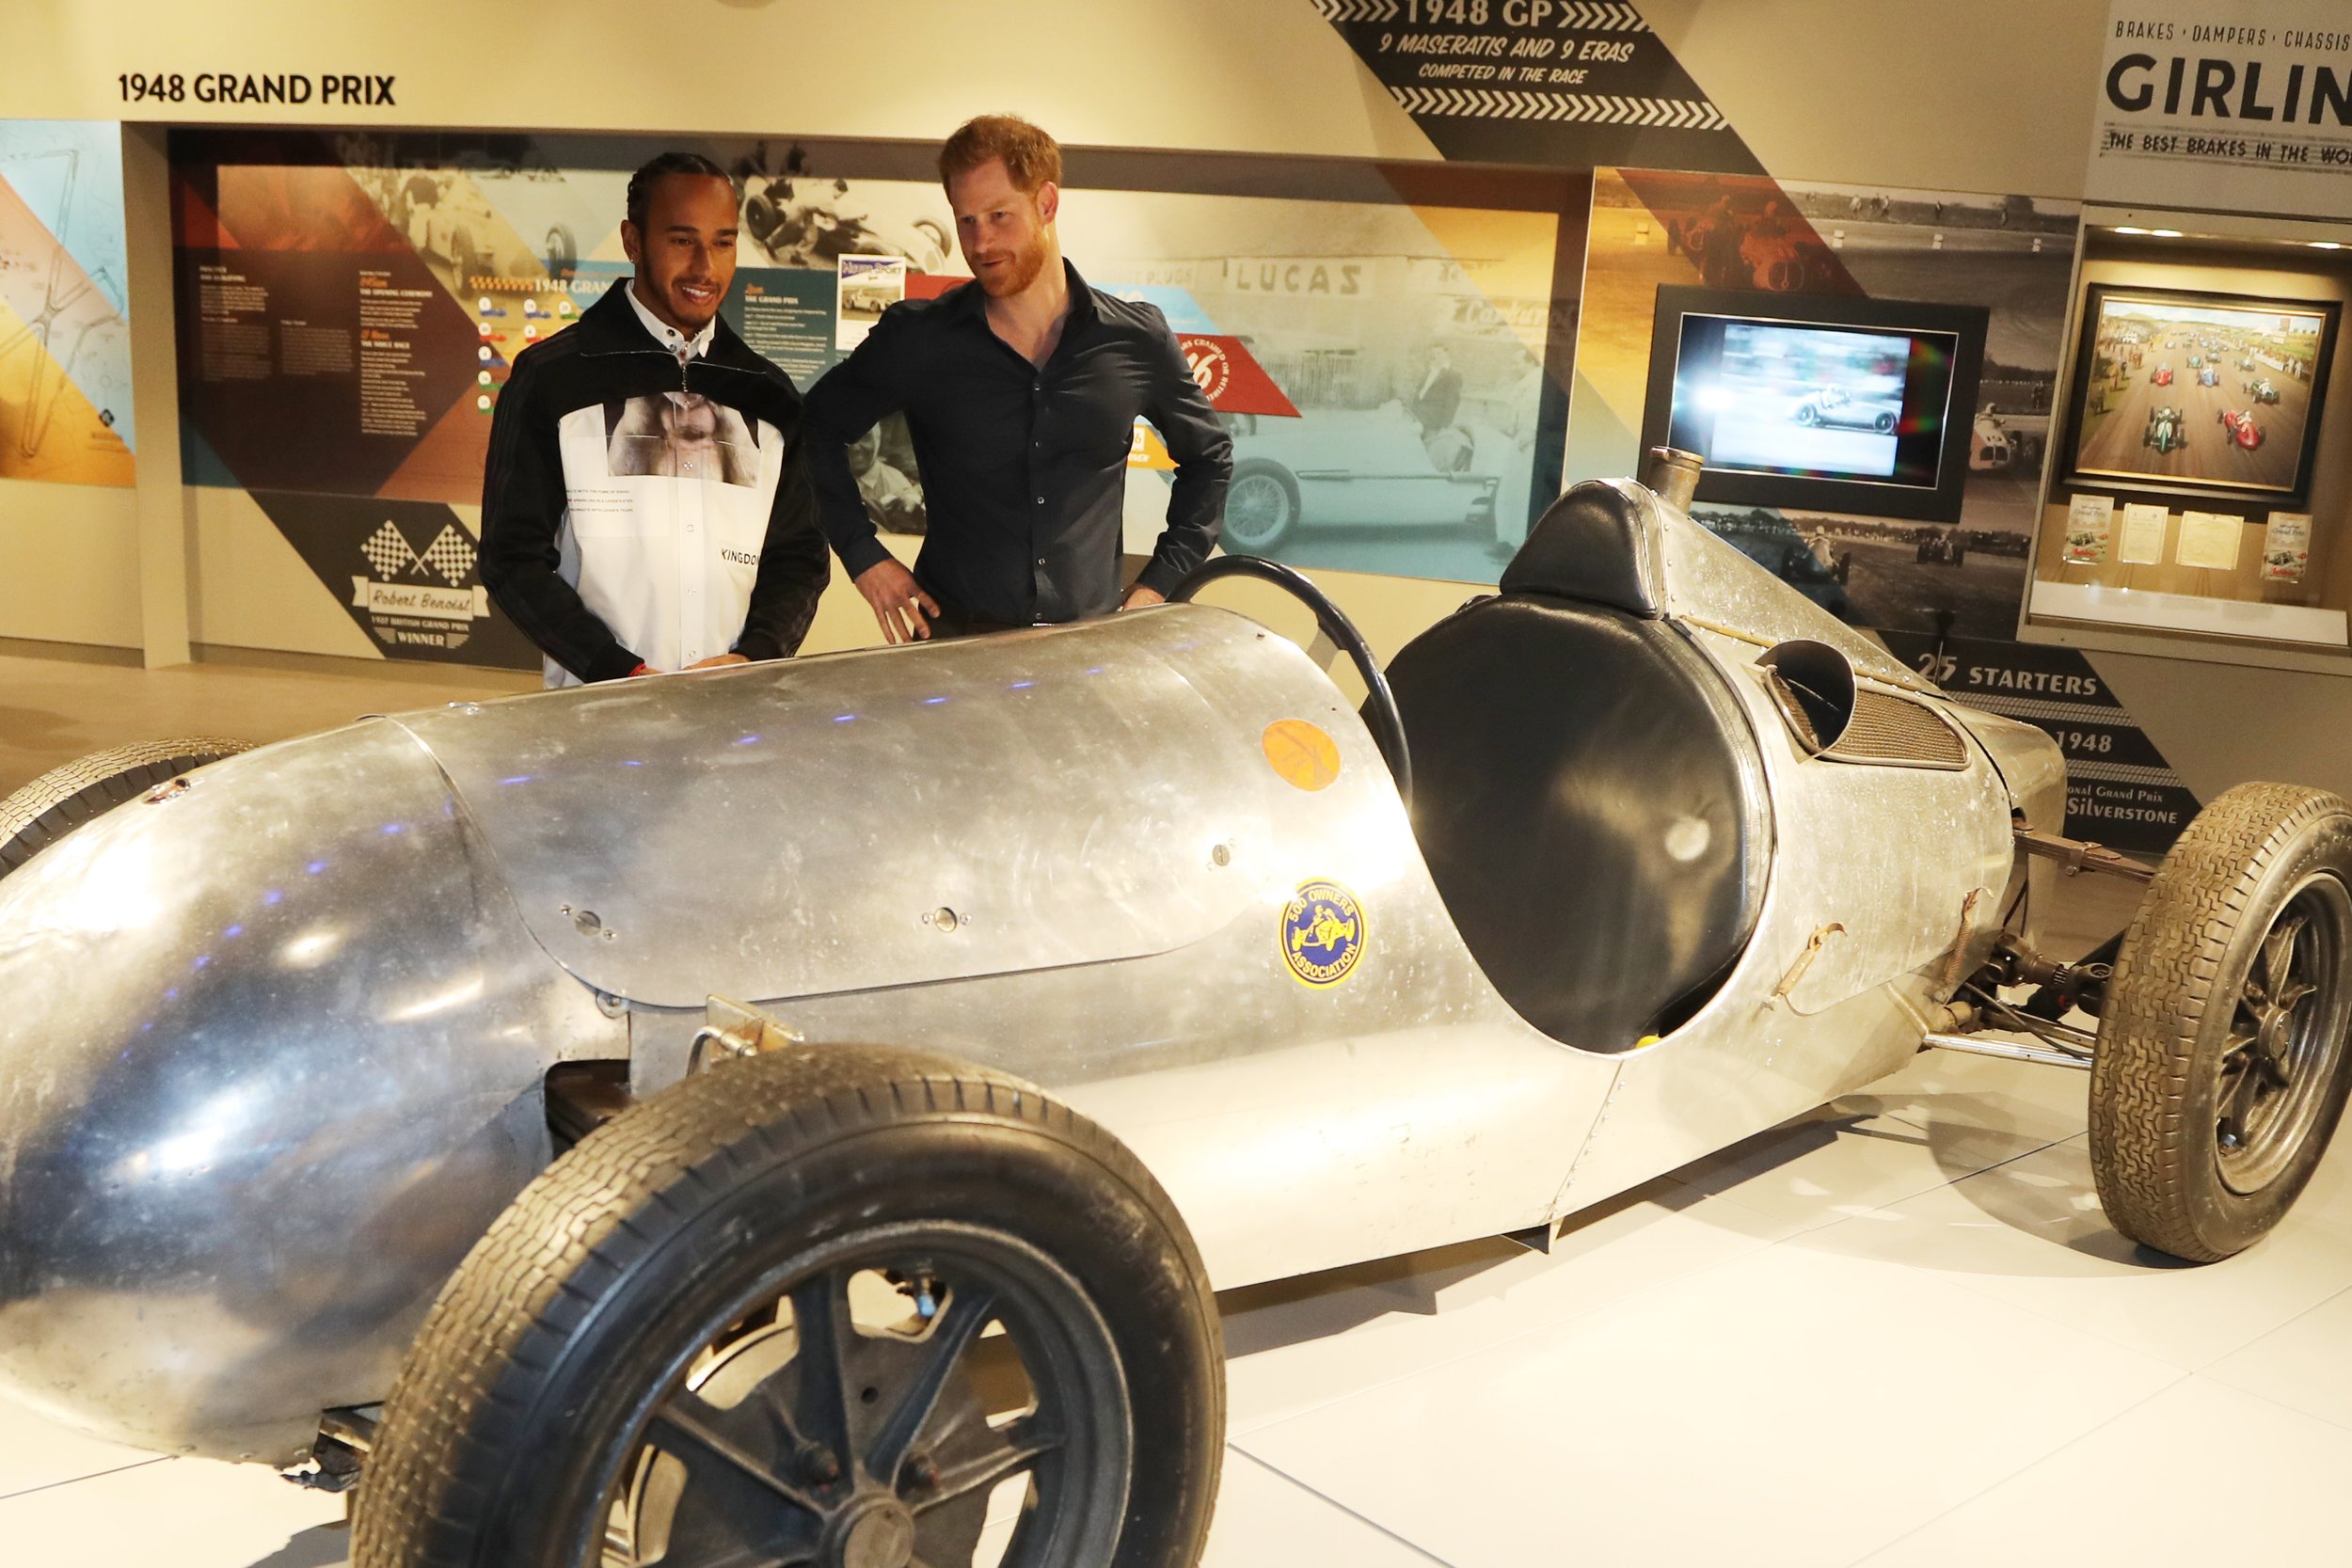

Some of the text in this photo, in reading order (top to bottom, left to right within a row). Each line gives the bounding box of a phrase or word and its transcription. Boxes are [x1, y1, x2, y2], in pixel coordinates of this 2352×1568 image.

[1406, 0, 1553, 27] 1948 GP
[1378, 33, 1635, 63] 9 MASERATIS AND 9 ERAS
[2116, 21, 2351, 52] BRAKES DAMPERS CHASSIS
[119, 73, 396, 105] 1948 GRAND PRIX
[1419, 64, 1589, 85] COMPETED IN THE RACE
[2108, 130, 2352, 166] THE BEST BRAKES IN THE WO
[534, 278, 568, 293] 1948
[1236, 264, 1362, 294] LUCAS
[1206, 376, 1229, 402] RETIRE
[372, 590, 470, 611] Robert Benoist
[397, 631, 445, 646] WINNER
[1917, 653, 2097, 696] 25 STARTERS
[2056, 730, 2112, 753] 1948
[1288, 889, 1355, 923] 500 OWNERS
[1291, 942, 1358, 978] ASSOCIATION
